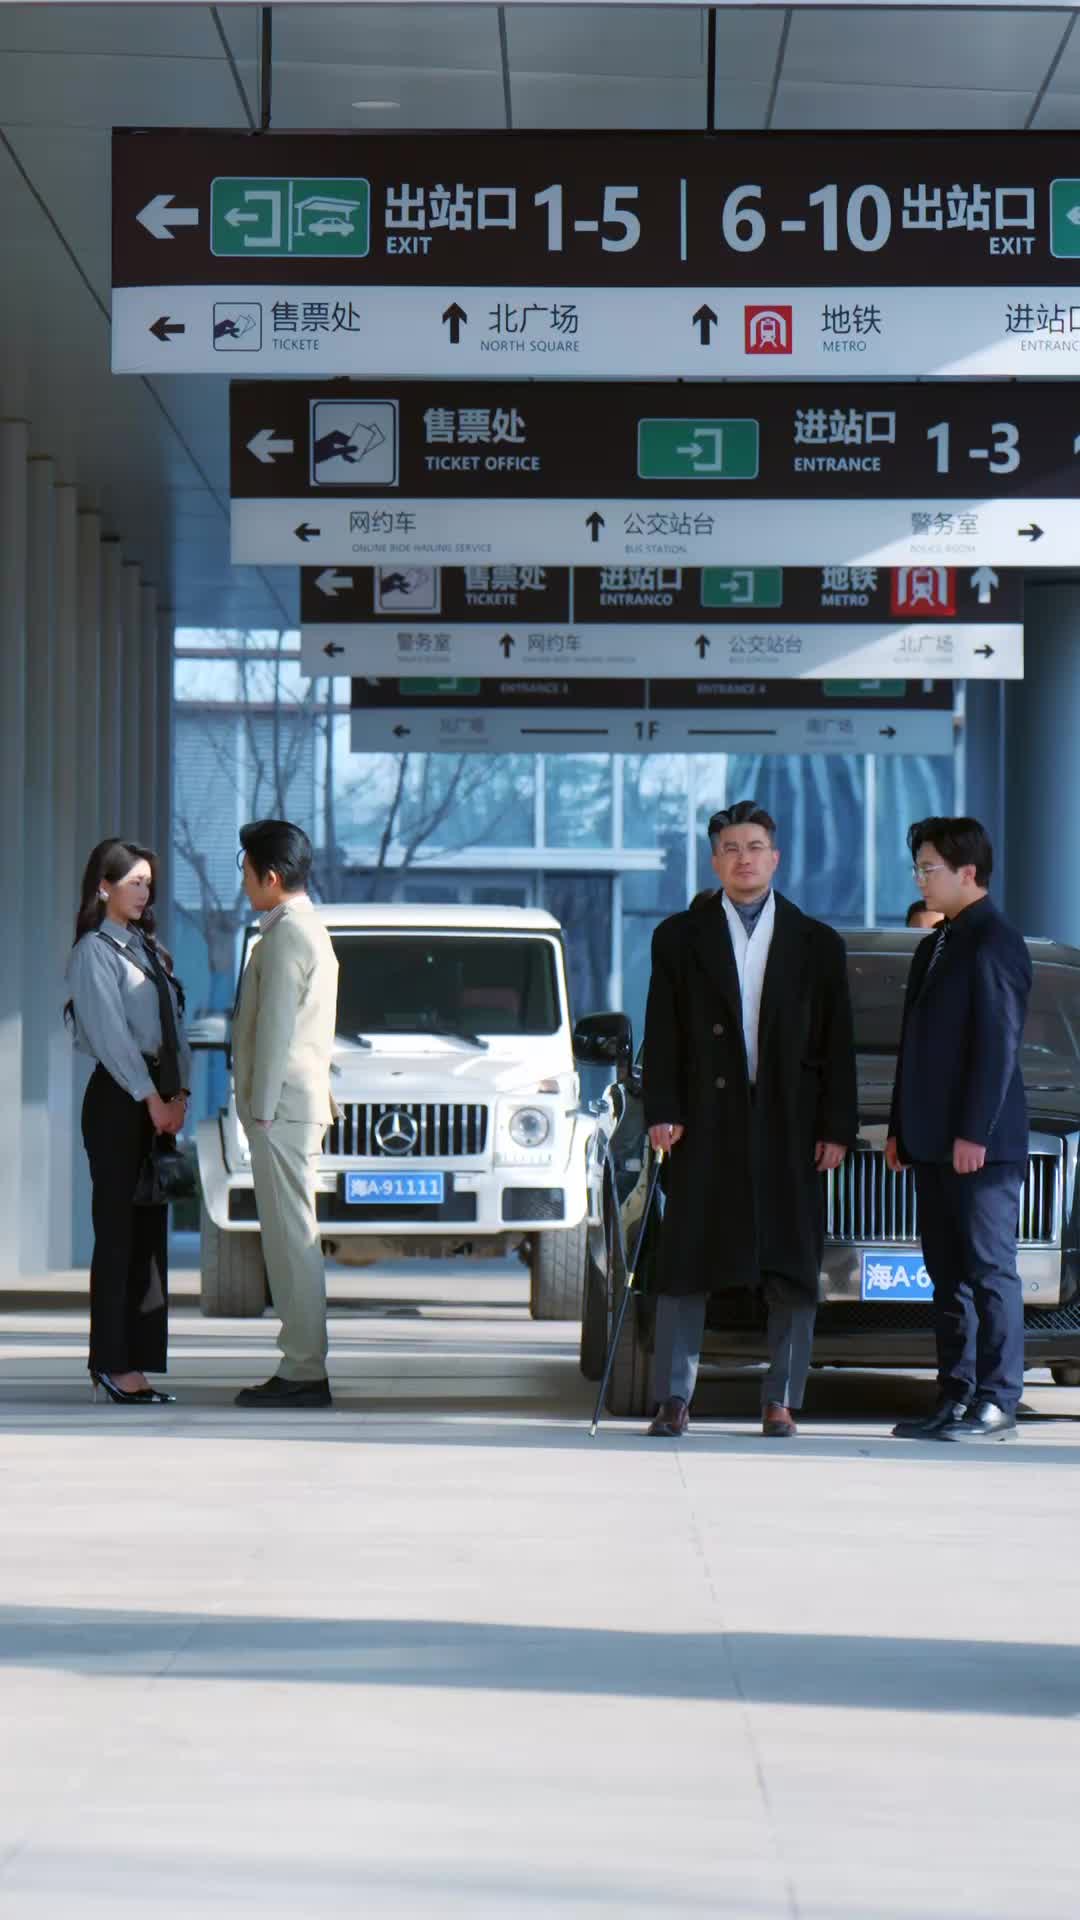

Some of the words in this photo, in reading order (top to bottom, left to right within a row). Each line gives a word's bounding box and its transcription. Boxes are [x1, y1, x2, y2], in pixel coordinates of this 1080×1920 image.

[384, 183, 517, 231] 出站口
[534, 184, 641, 253] 1-5
[901, 183, 1036, 231] 出站口
[386, 236, 433, 255] EXIT
[989, 236, 1036, 255] EXIT
[271, 301, 361, 333] 售票处
[488, 303, 579, 334] 北广场
[821, 304, 882, 335] 地铁
[272, 338, 319, 351] TICKETE
[480, 340, 525, 352] NORTH
[529, 340, 579, 353] SQUARE
[822, 340, 867, 353] METRO
[423, 407, 526, 444] 售票处
[793, 408, 896, 445] 进站口
[424, 455, 481, 471] TICKET
[484, 455, 541, 471] OFFICE
[794, 457, 881, 472] ENTRANCE
[349, 511, 417, 534] 网约车
[623, 511, 715, 536] 公交站台
[910, 512, 979, 536] 警务室
[821, 567, 878, 592] 地铁
[465, 592, 518, 606] TICKETE
[821, 593, 869, 607] METRO
[635, 720, 660, 740] 1F
